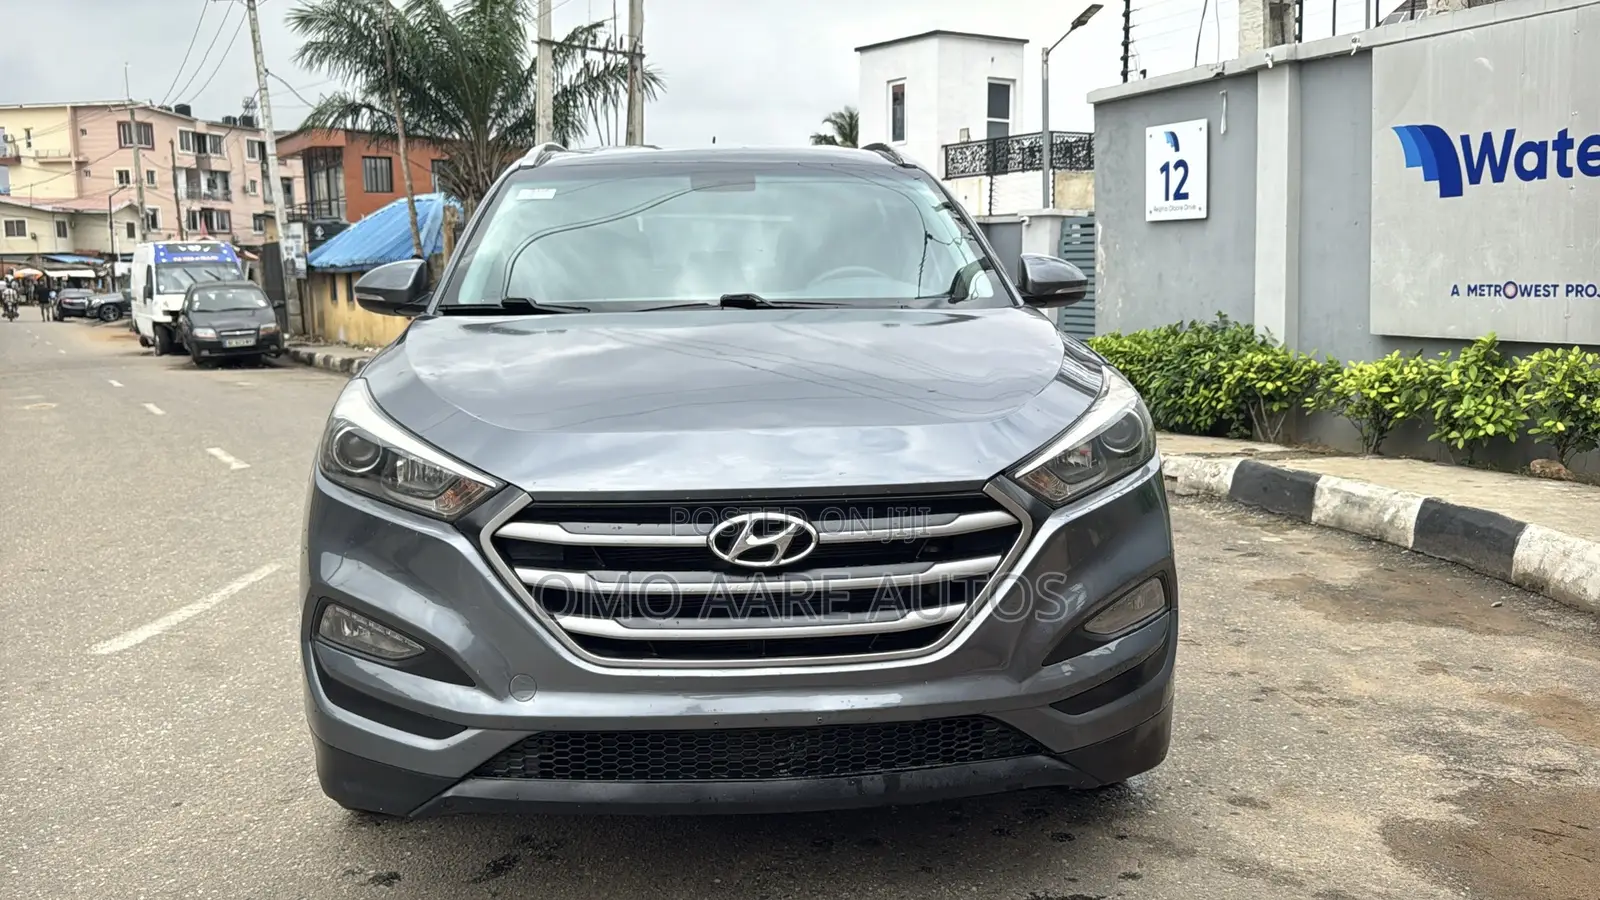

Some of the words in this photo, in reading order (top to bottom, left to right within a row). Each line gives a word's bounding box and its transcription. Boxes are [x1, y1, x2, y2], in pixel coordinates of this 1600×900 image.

[1460, 128, 1600, 185] Wate
[1159, 159, 1189, 201] 12
[1450, 284, 1460, 297] A
[1467, 281, 1559, 299] METROWEST
